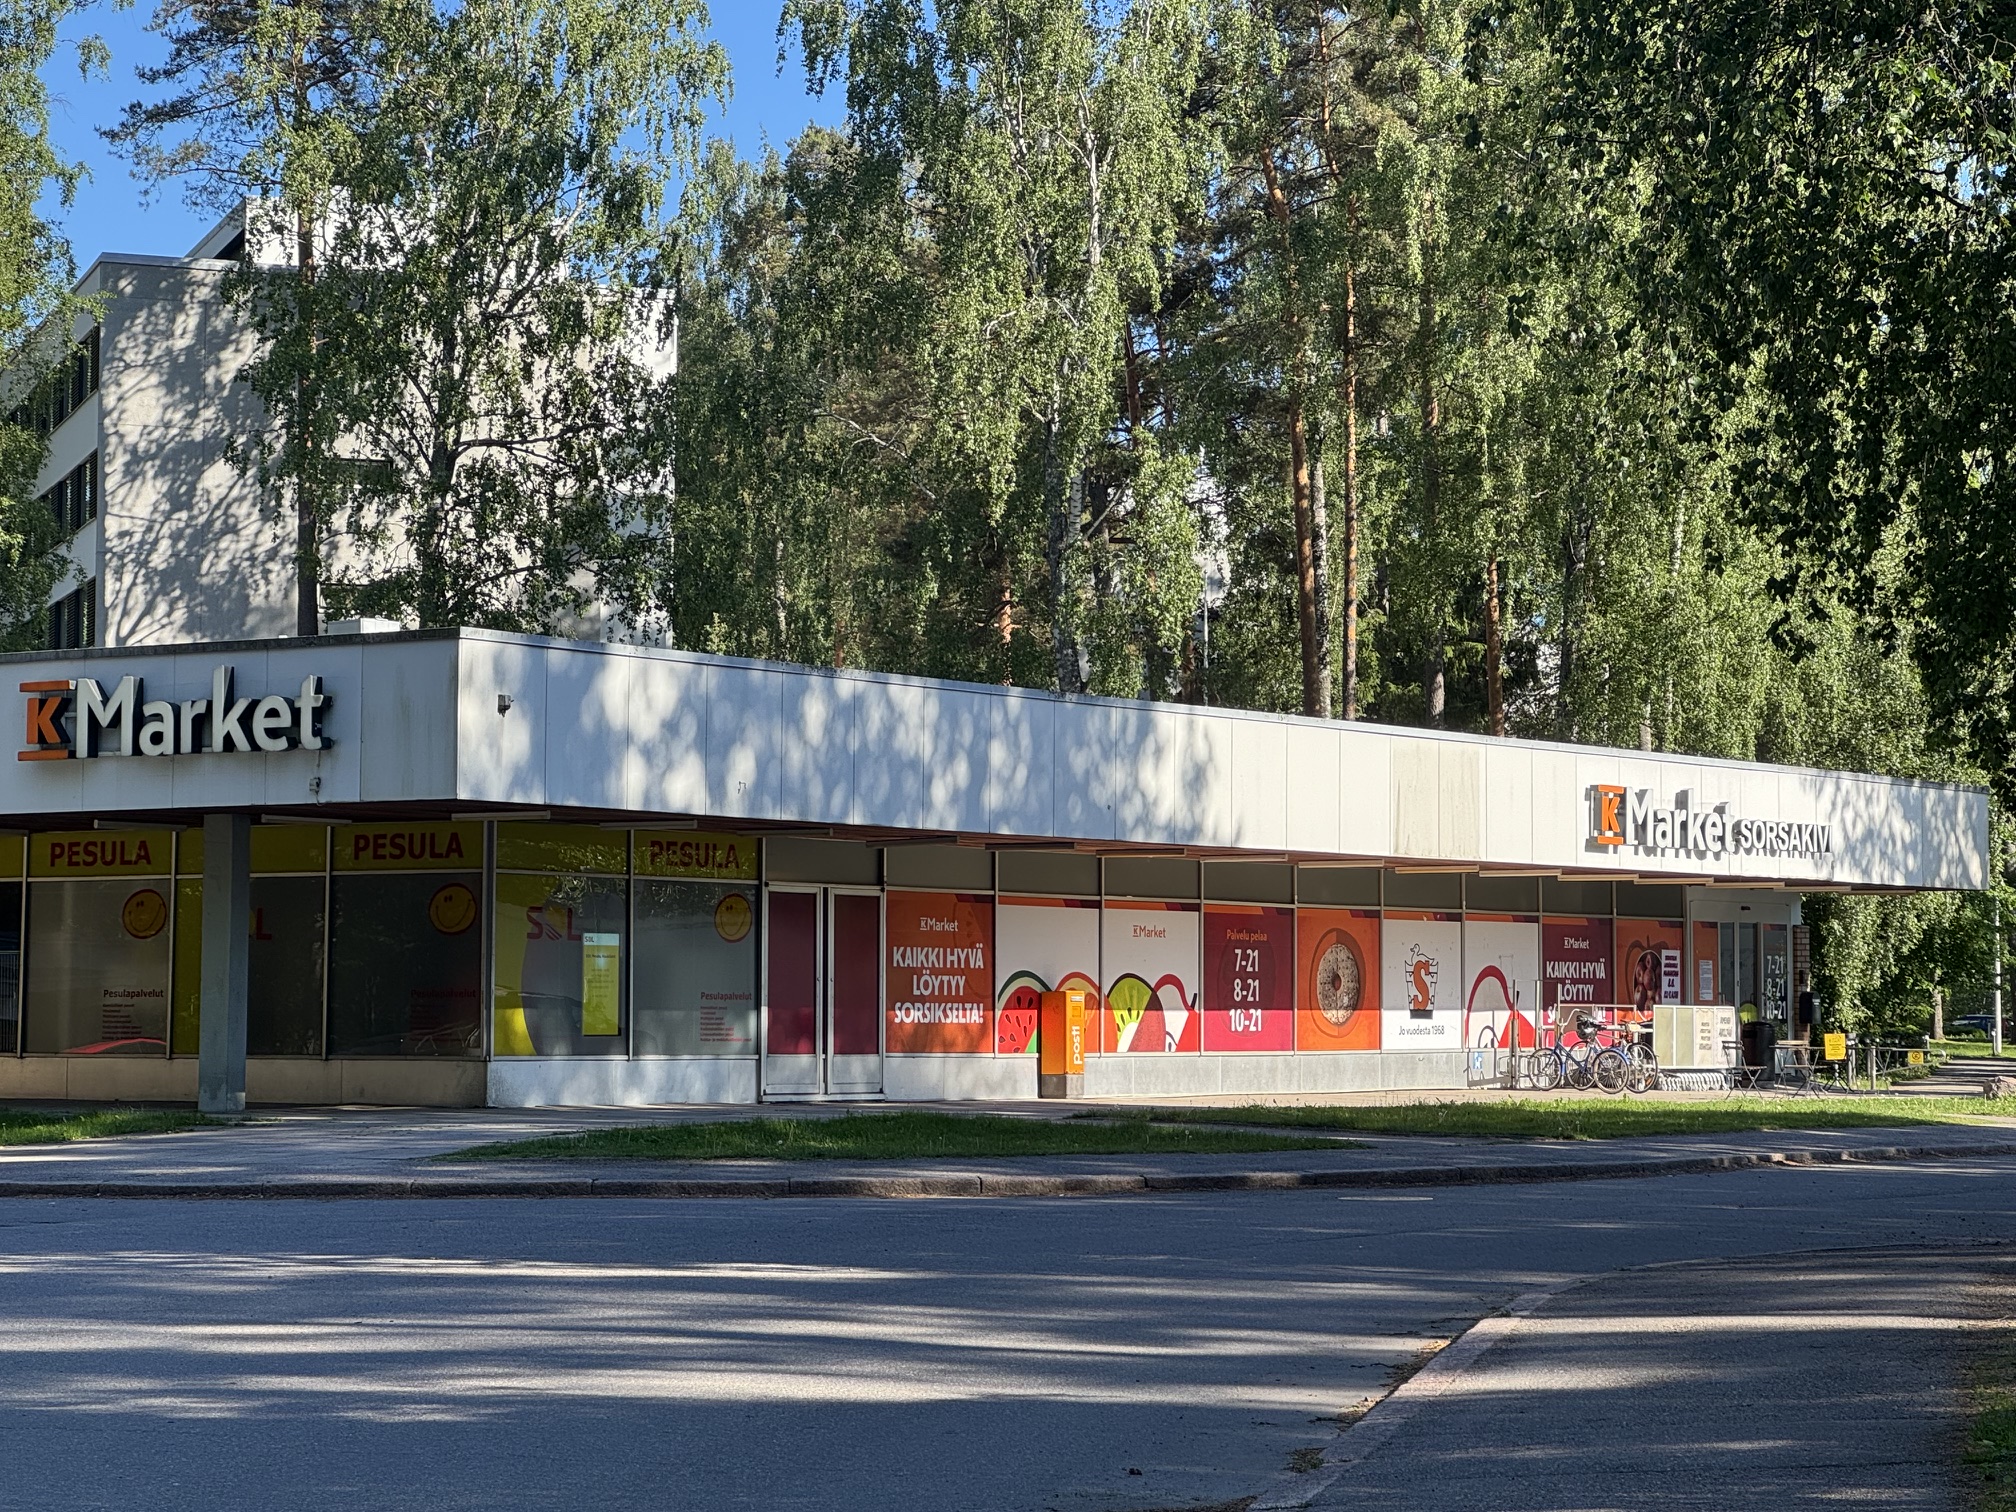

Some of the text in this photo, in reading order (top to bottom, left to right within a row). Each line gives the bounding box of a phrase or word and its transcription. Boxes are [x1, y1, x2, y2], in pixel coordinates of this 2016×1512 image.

[50, 841, 151, 867] PESULA
[353, 832, 464, 860] PESULA
[649, 840, 740, 869] PESULA
[1226, 929, 1267, 943] Palvelu pelaa
[893, 943, 984, 969] KAIKKI HYVÄ
[1234, 949, 1259, 972] 7-21
[1766, 955, 1784, 975] 7-21
[1546, 958, 1606, 980] KAIKKI HYVÄ
[913, 969, 966, 996] LÖYTYY
[1233, 978, 1259, 1002] 8-21
[1559, 980, 1594, 1001] LÖYTYY
[1766, 978, 1785, 997] 8-21
[103, 989, 164, 999] Pesulapalvelut
[700, 991, 752, 1002] Pesulapalvelut
[894, 1002, 984, 1024] SORSIKSELTA!
[1229, 1008, 1262, 1032] 10-21
[1766, 1000, 1787, 1020] 10-21
[1398, 1025, 1445, 1036] Jo vuodesta 1968
[1073, 1025, 1083, 1065] posti
